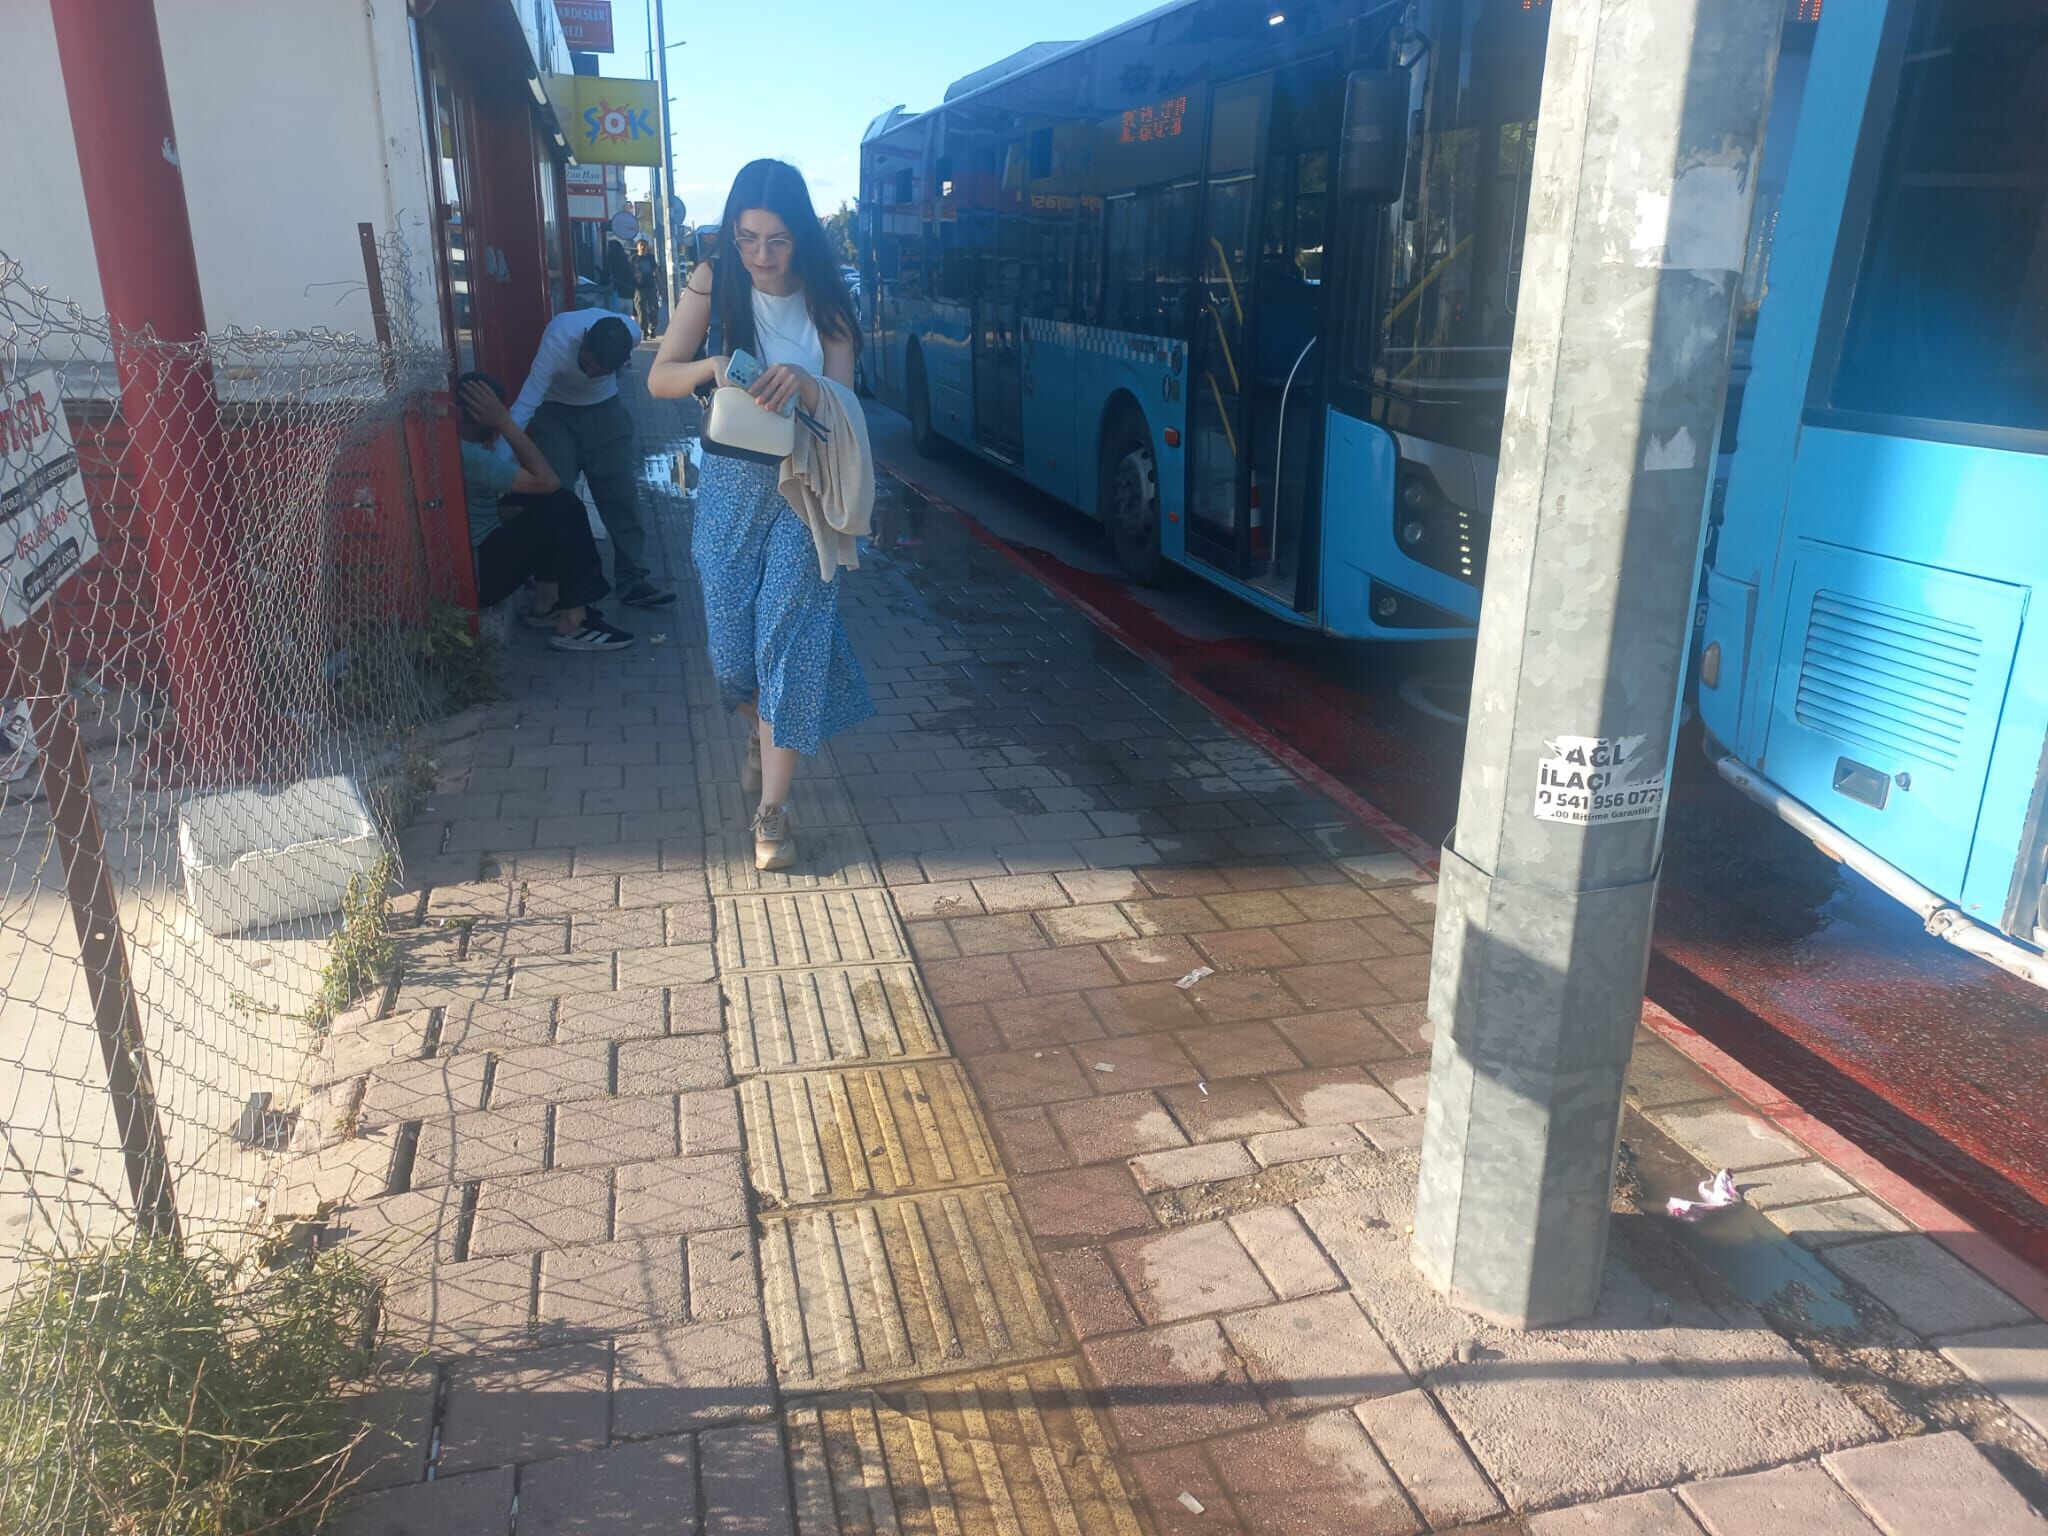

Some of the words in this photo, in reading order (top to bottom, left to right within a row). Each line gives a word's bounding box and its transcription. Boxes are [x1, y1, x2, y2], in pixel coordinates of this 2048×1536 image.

[558, 7, 607, 22] ARDEŞLER
[584, 106, 655, 145] ŞOK
[1556, 793, 1588, 809] 541
[1594, 793, 1624, 809] 956
[1572, 812, 1608, 821] Bitirme
